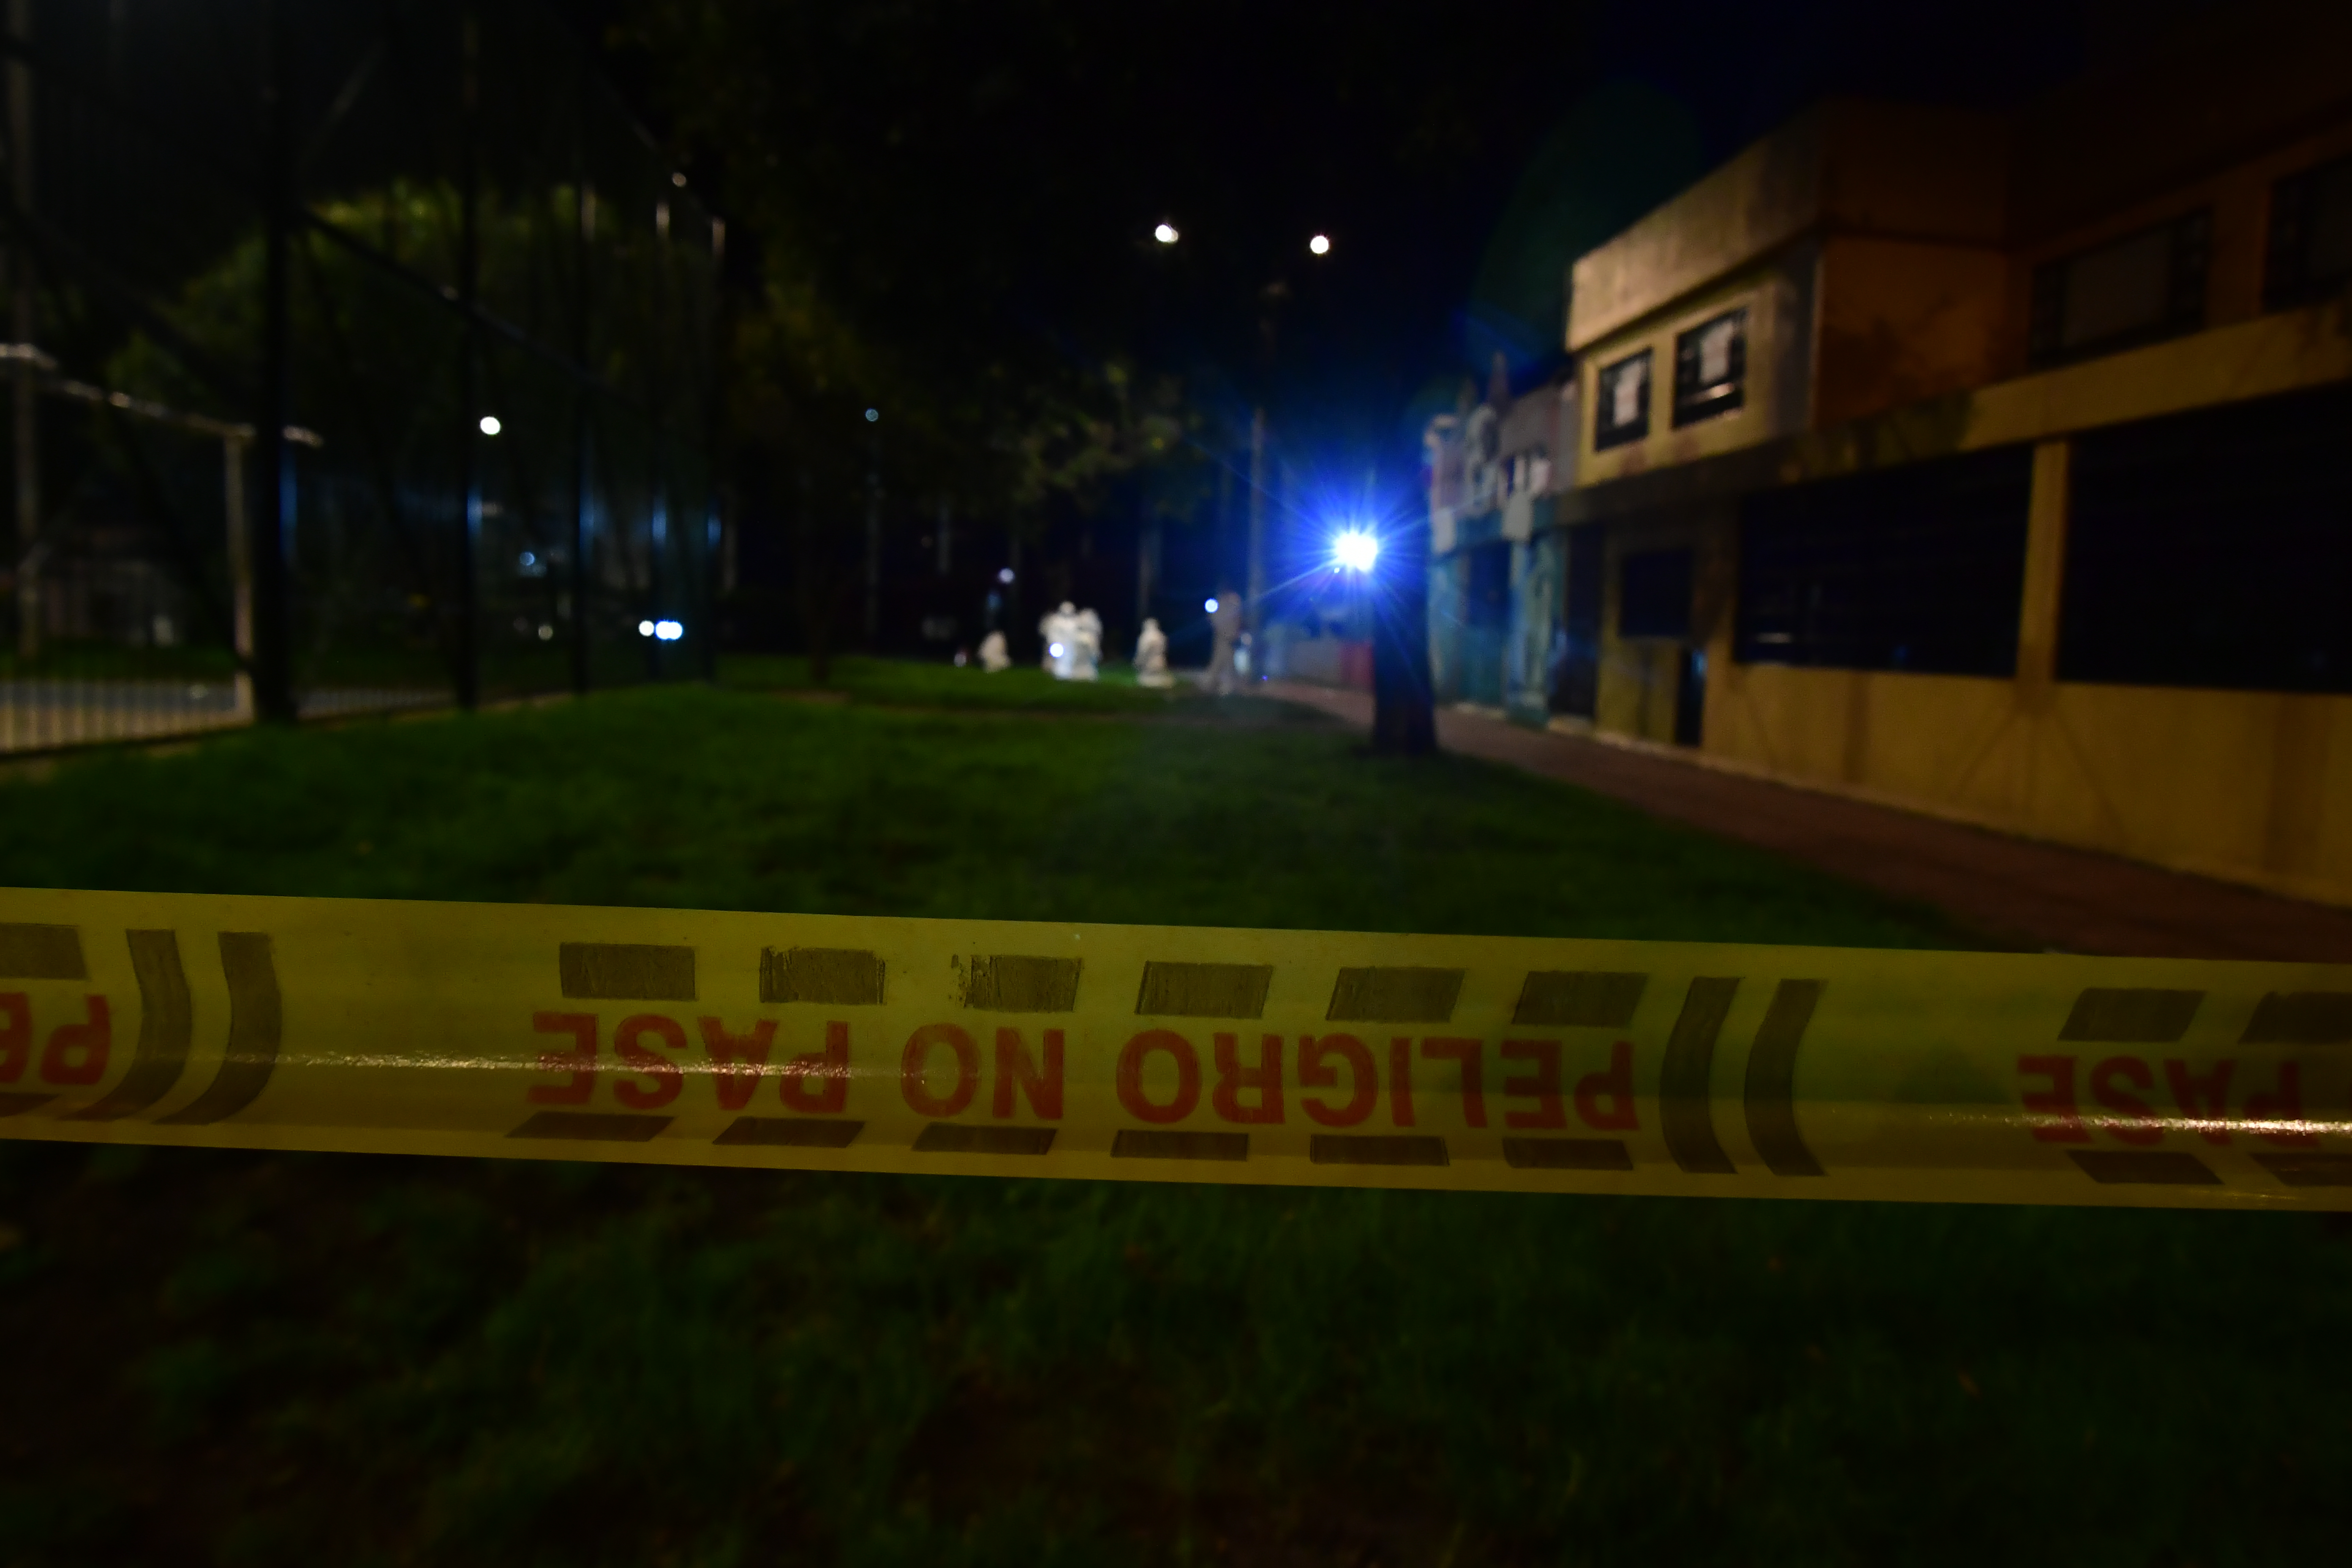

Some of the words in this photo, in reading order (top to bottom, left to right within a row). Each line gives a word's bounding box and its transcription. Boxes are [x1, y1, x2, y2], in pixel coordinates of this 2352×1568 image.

[525, 1011, 852, 1113] PASE
[900, 1022, 1065, 1120] NO
[1116, 1028, 1640, 1131] PELIGRO
[2017, 1054, 2322, 1148] PASE
